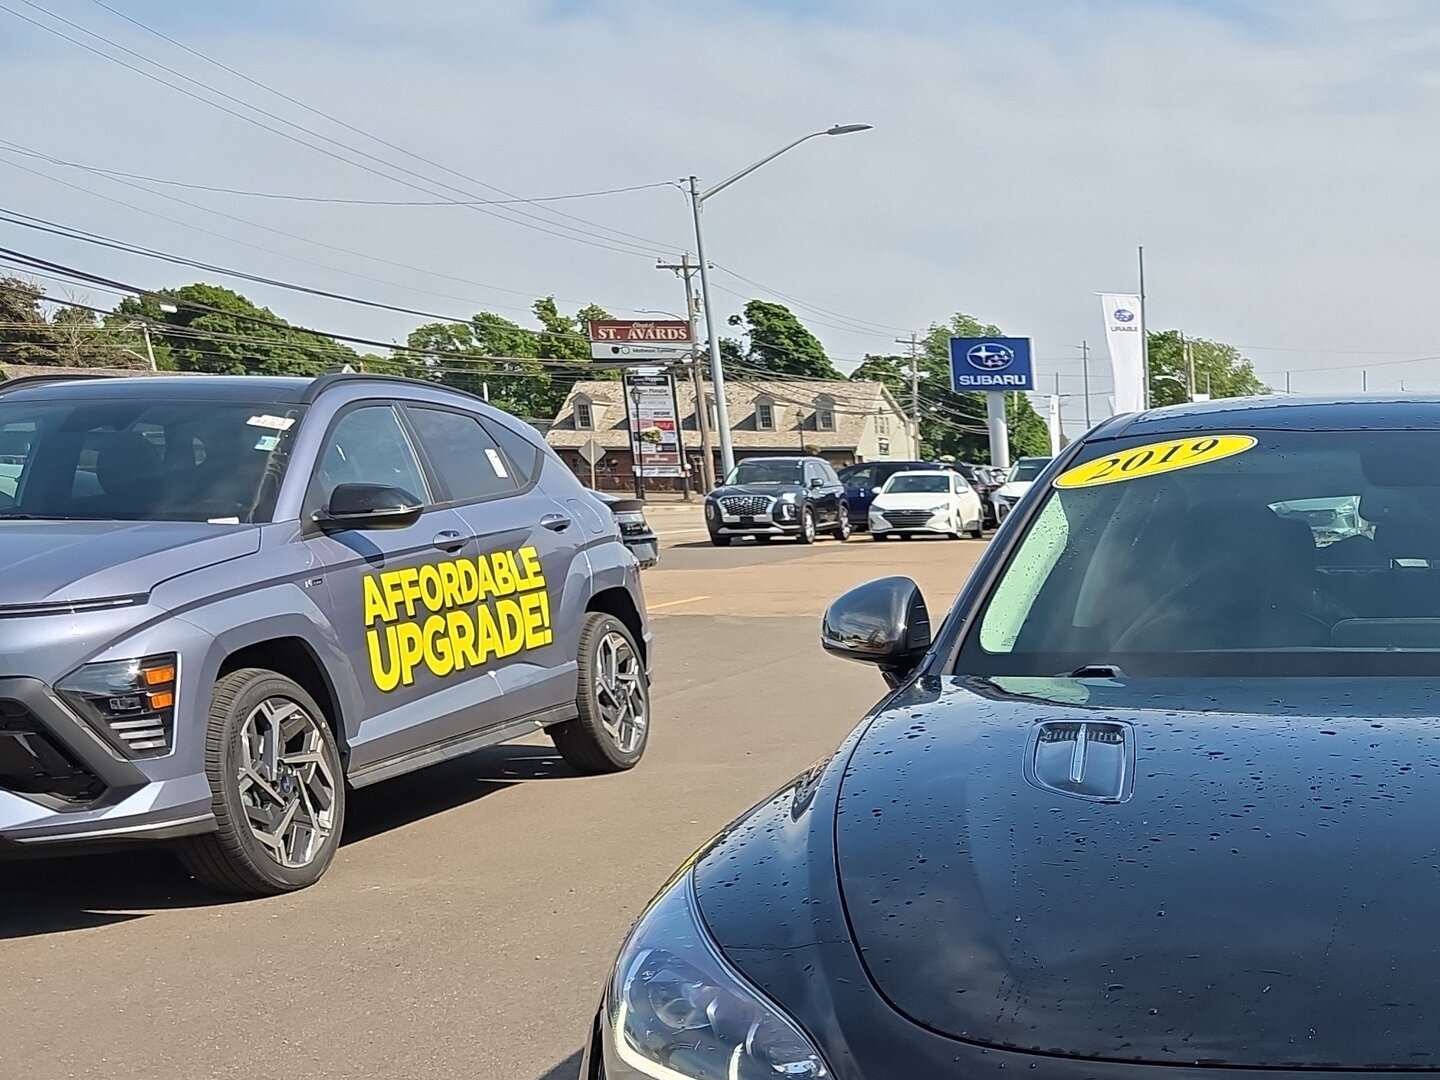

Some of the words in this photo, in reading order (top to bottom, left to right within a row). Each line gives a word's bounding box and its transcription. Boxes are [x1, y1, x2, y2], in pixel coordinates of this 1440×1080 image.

[598, 328, 621, 339] ST.
[627, 328, 688, 340] AVARDS
[959, 374, 1026, 386] SUBARU
[1085, 438, 1220, 483] 2019
[363, 546, 547, 626] AFFORDABLE
[366, 591, 553, 692] UPGRADE!
